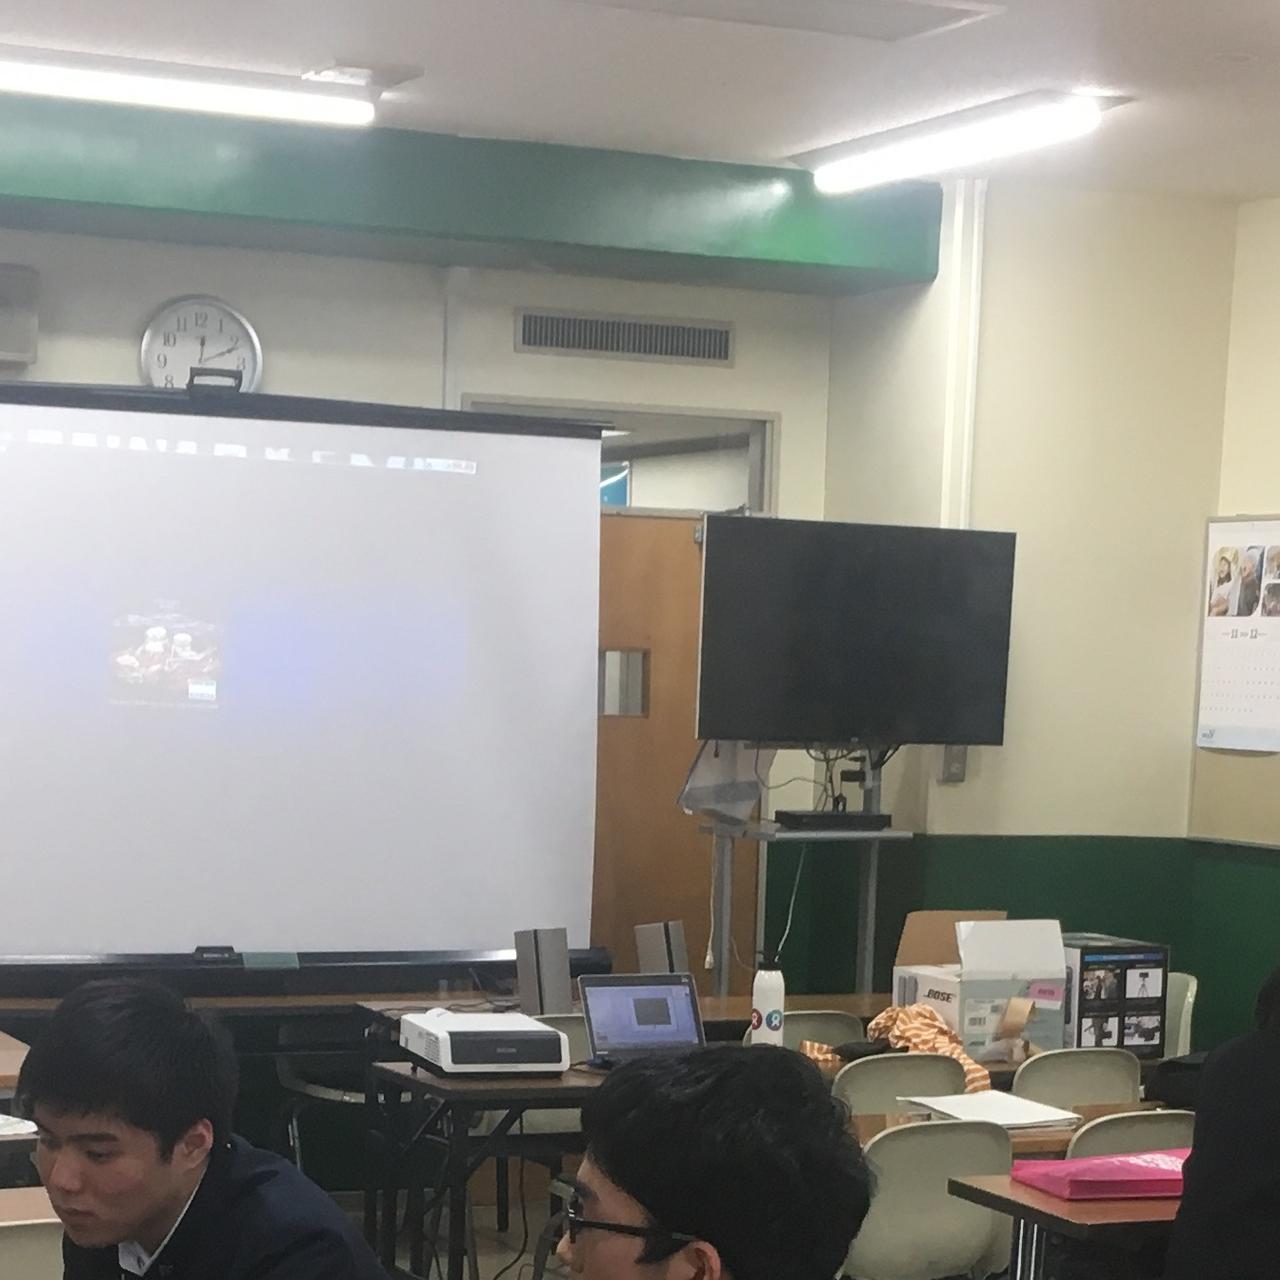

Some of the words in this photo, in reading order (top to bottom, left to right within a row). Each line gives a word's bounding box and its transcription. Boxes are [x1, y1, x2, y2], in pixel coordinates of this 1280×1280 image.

[176, 316, 188, 332] 11
[194, 312, 208, 328] 12
[163, 331, 176, 347] 10
[157, 353, 167, 368] 9
[236, 356, 246, 371] 3
[164, 374, 174, 389] 8
[926, 988, 953, 1003] BOSE
